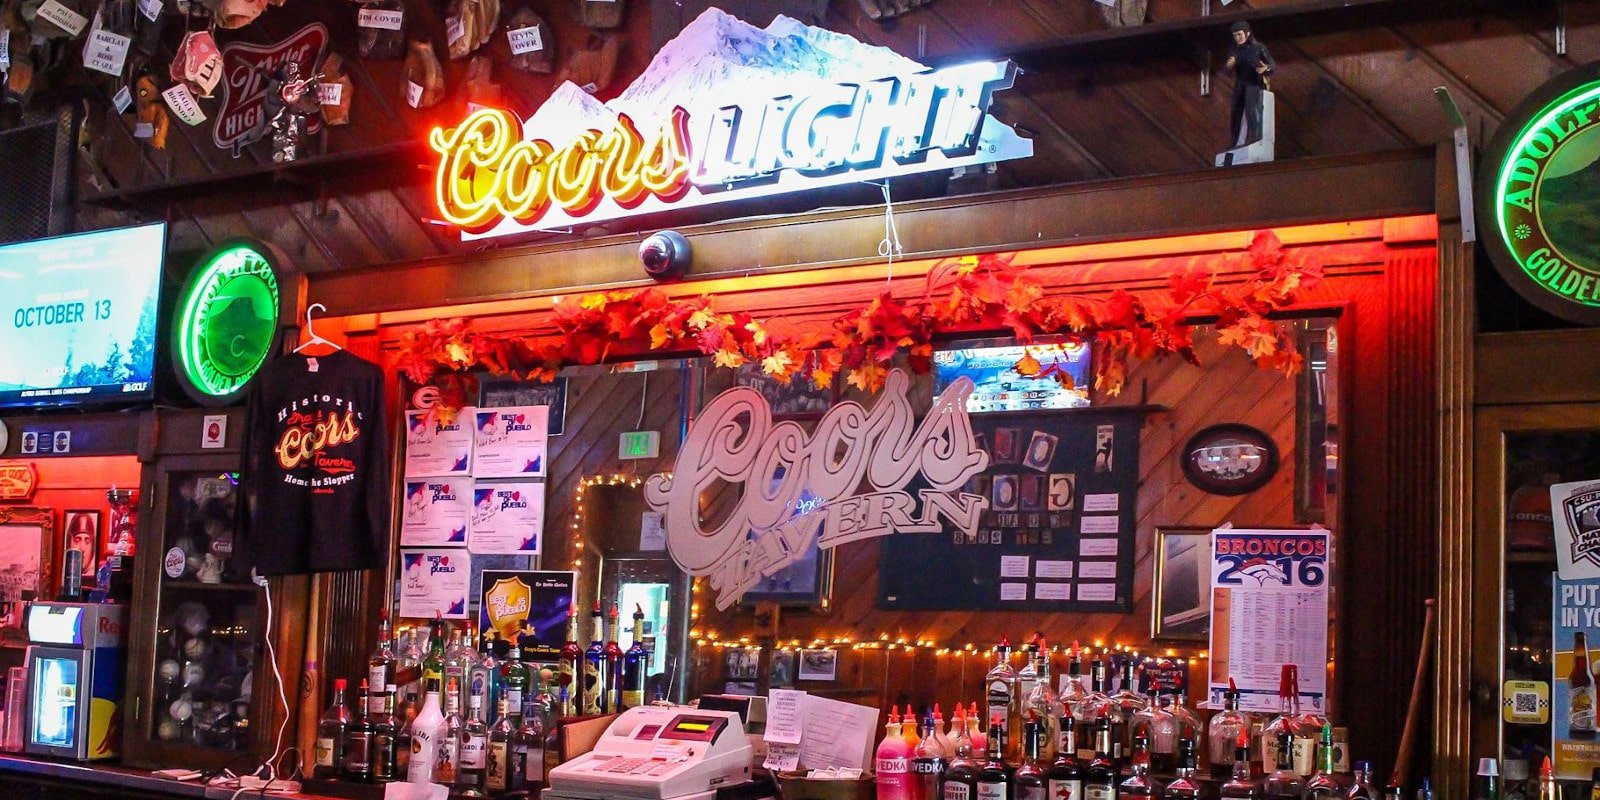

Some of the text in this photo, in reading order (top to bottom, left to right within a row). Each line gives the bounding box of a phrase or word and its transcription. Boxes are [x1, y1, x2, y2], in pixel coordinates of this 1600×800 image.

[374, 15, 401, 24] COVER
[96, 34, 126, 46] BARCLAY
[513, 40, 538, 50] OVER
[92, 59, 114, 71] CLARK
[429, 60, 1024, 234] Coors LIGHT
[1505, 102, 1600, 213] ADOLP
[14, 299, 112, 328] OCTOBER 13
[277, 394, 363, 422] Historic
[436, 424, 460, 436] PUEBLO
[505, 424, 532, 436] PUEBLO
[275, 411, 360, 470] Coors
[314, 451, 355, 468] Tavern
[323, 474, 355, 486] Slopper
[644, 367, 990, 582] Coors
[432, 494, 457, 505] PUEBLO
[501, 502, 527, 512] PUEBLO
[711, 488, 989, 612] TAVERN
[1216, 538, 1326, 556] BRONCOS
[431, 567, 456, 576] PUEBLO
[1217, 555, 1326, 588] 216
[1562, 584, 1600, 607] PUT
[100, 617, 120, 634] Re
[1562, 608, 1579, 627] IN
